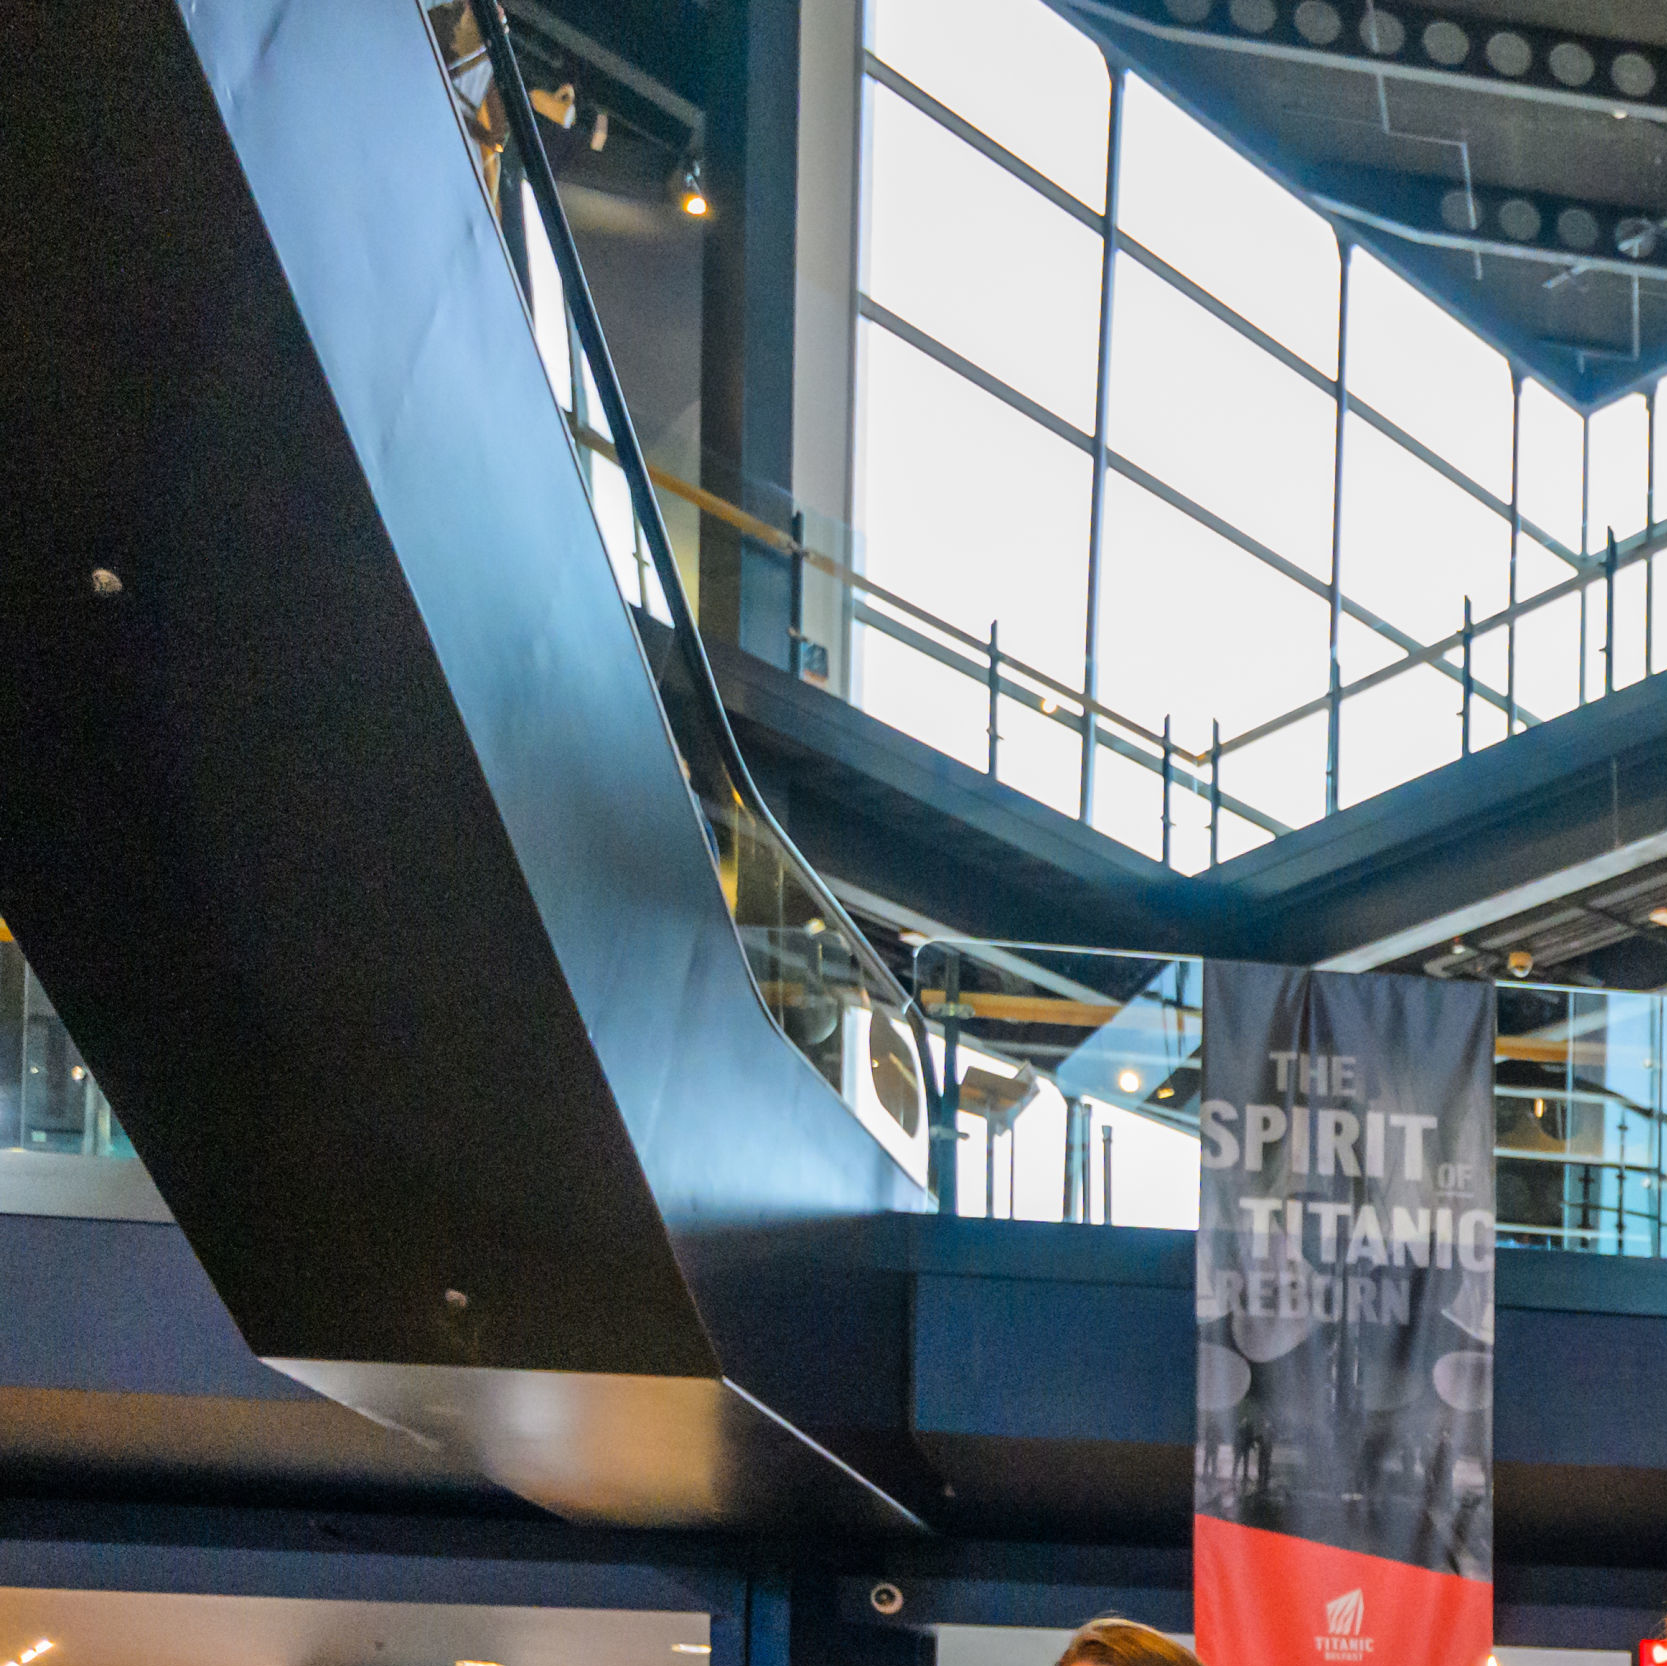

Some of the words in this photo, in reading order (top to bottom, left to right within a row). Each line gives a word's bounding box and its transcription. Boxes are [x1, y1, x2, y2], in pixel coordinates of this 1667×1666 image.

[1268, 1050, 1357, 1098] THE
[1201, 1099, 1438, 1182] SPIRIT
[1437, 1162, 1474, 1192] OF
[1239, 1197, 1495, 1272] TITANIC
[1214, 1269, 1411, 1326] REBORN
[1313, 1635, 1375, 1653] TITANIC
